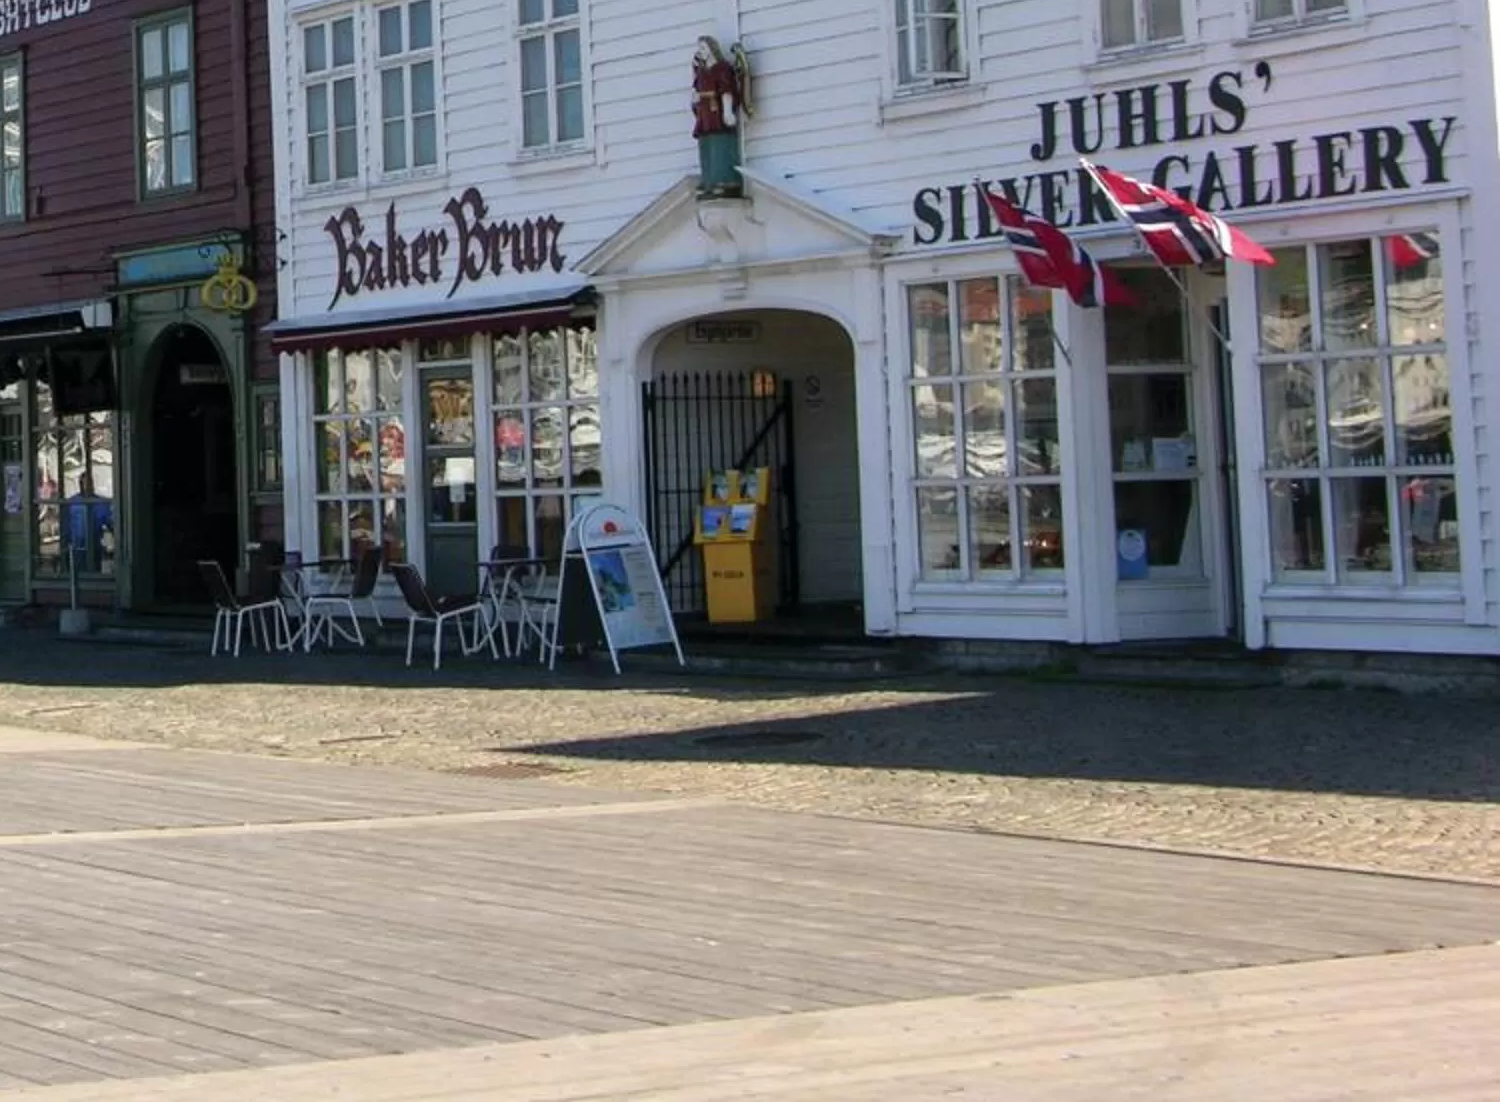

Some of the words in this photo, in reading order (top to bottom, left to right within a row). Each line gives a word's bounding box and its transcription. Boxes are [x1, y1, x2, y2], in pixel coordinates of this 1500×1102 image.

[1151, 116, 1457, 213] GALLERY
[323, 200, 450, 311] Baker
[443, 187, 566, 299] Brun
